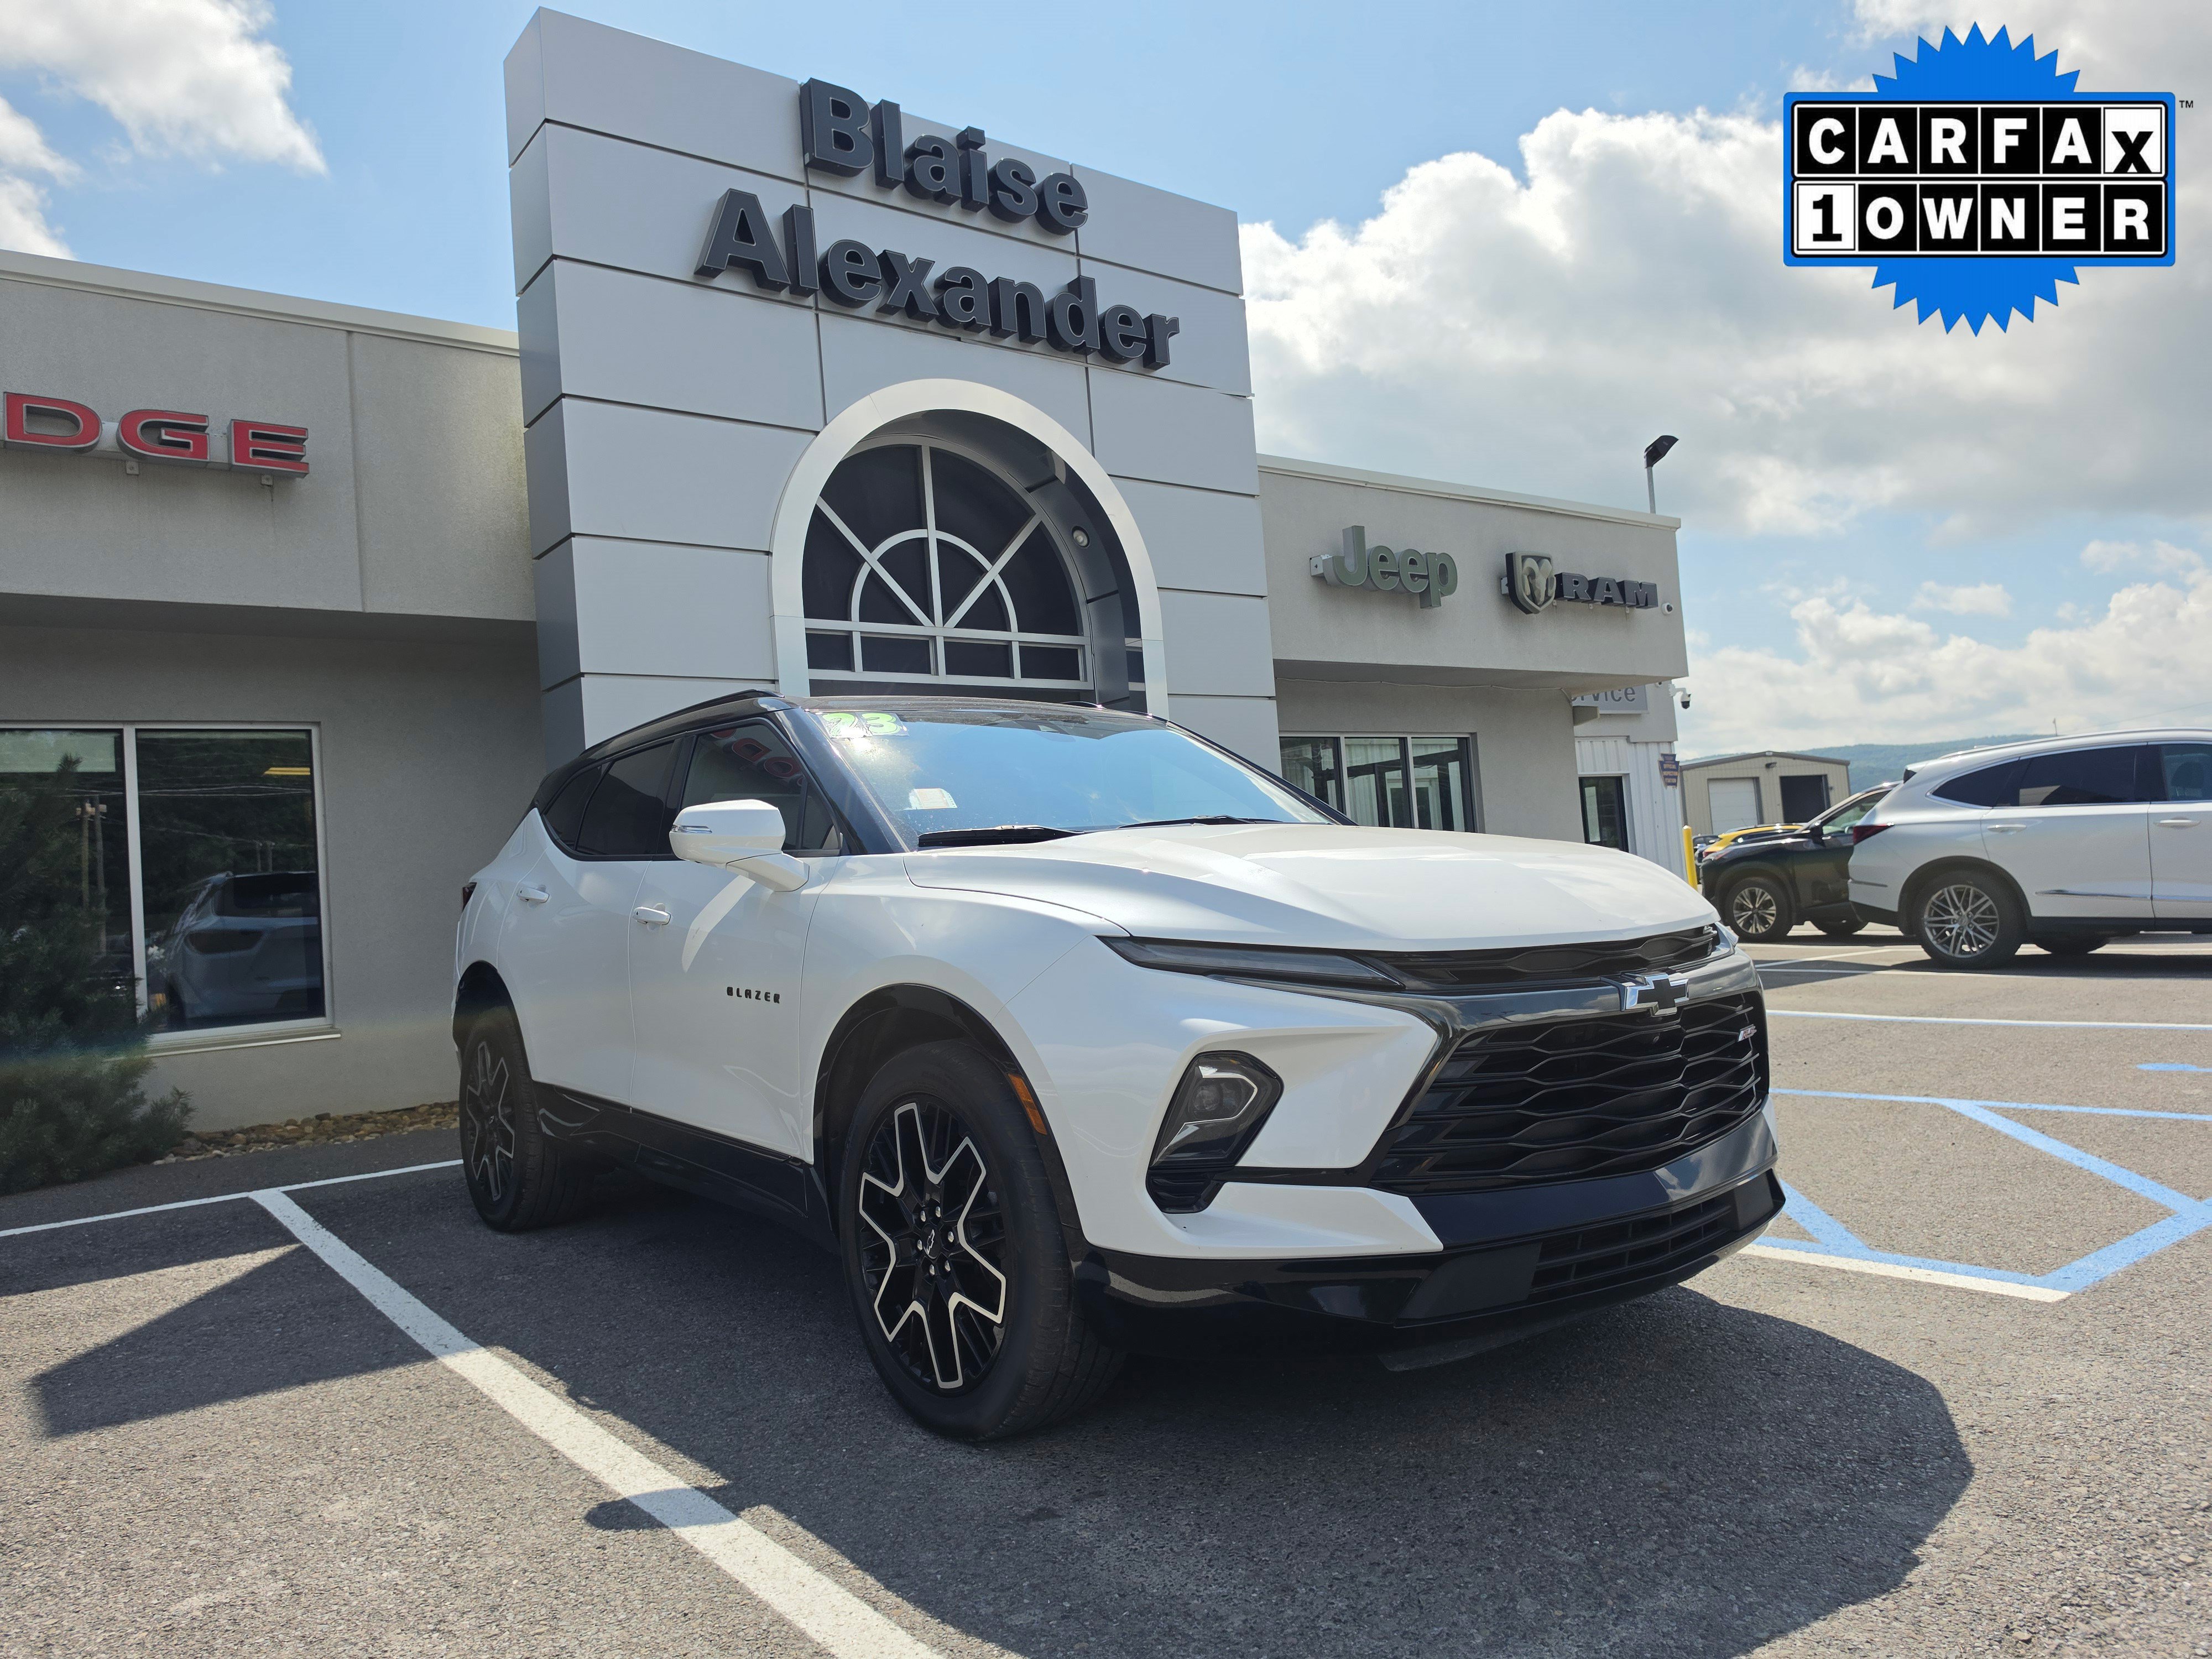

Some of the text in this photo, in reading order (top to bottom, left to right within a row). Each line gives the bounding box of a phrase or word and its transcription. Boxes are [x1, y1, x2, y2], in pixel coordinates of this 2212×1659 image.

[800, 77, 1088, 236] Blaise
[694, 188, 1180, 371] Alexander
[1323, 525, 1458, 609] Jeep
[1554, 572, 1658, 609] RAM
[727, 987, 780, 1004] BLAZER
